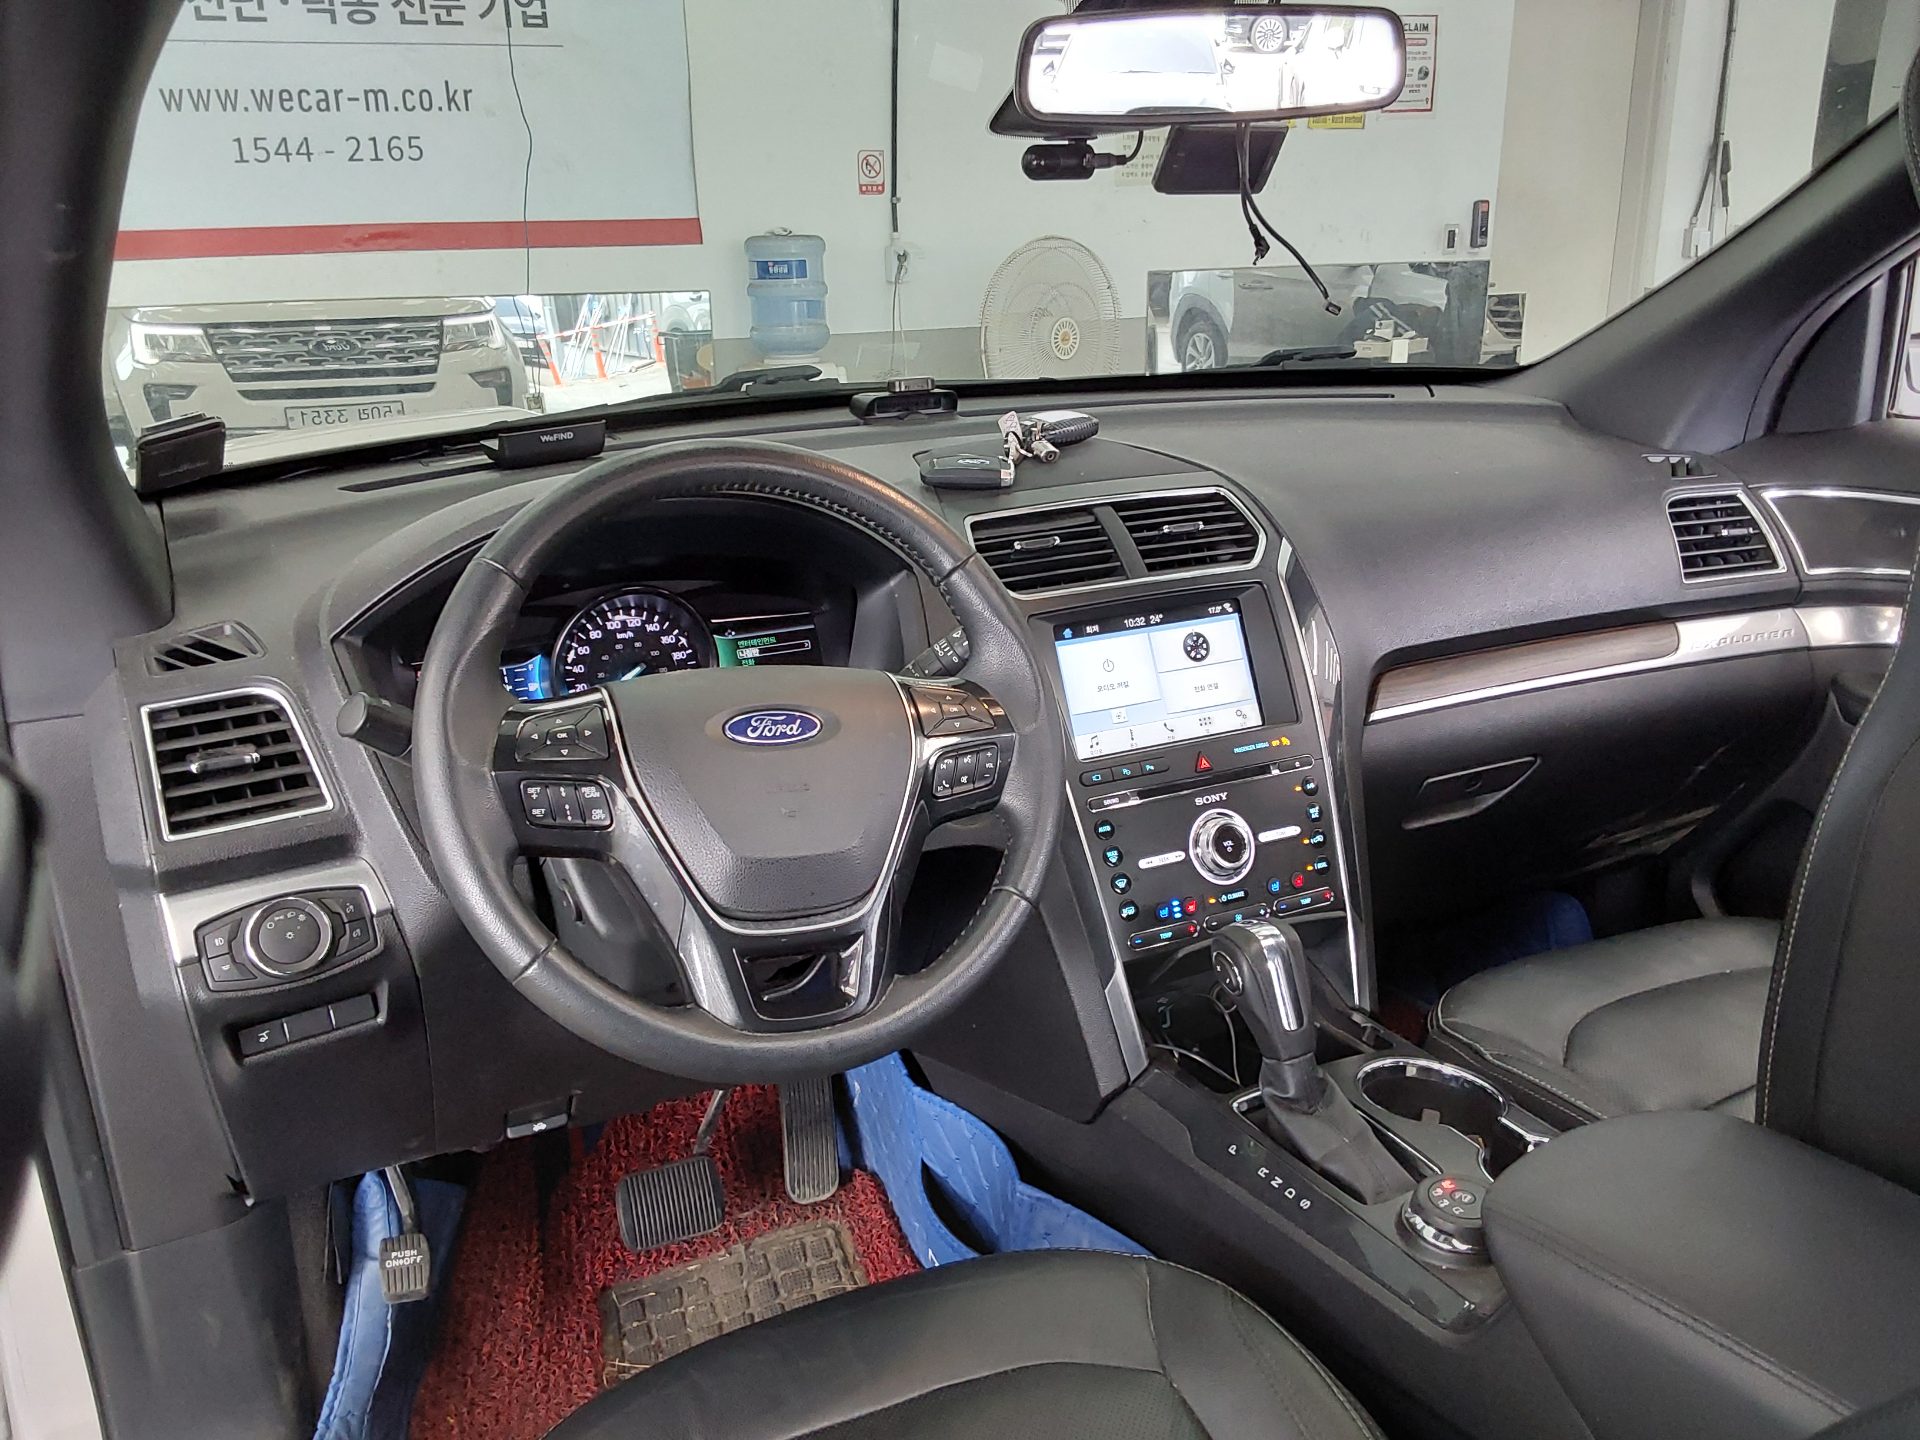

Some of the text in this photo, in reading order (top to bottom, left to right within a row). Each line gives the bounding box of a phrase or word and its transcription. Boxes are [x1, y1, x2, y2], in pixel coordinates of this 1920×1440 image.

[158, 80, 473, 113] www.wecar-m.co.kr
[232, 137, 314, 164] 1544
[345, 136, 424, 163] 2165
[605, 621, 621, 630] 100
[626, 620, 641, 628] 120
[1123, 616, 1146, 628] 10:32
[645, 623, 660, 632] 140
[589, 631, 602, 639] 80
[577, 646, 590, 655] 60
[572, 665, 584, 673] 40
[575, 683, 588, 692] 20
[747, 715, 802, 738] Ford
[1195, 792, 1228, 806] SONY
[1228, 1144, 1311, 1210] P R N D S
[391, 1249, 418, 1259] PUSH
